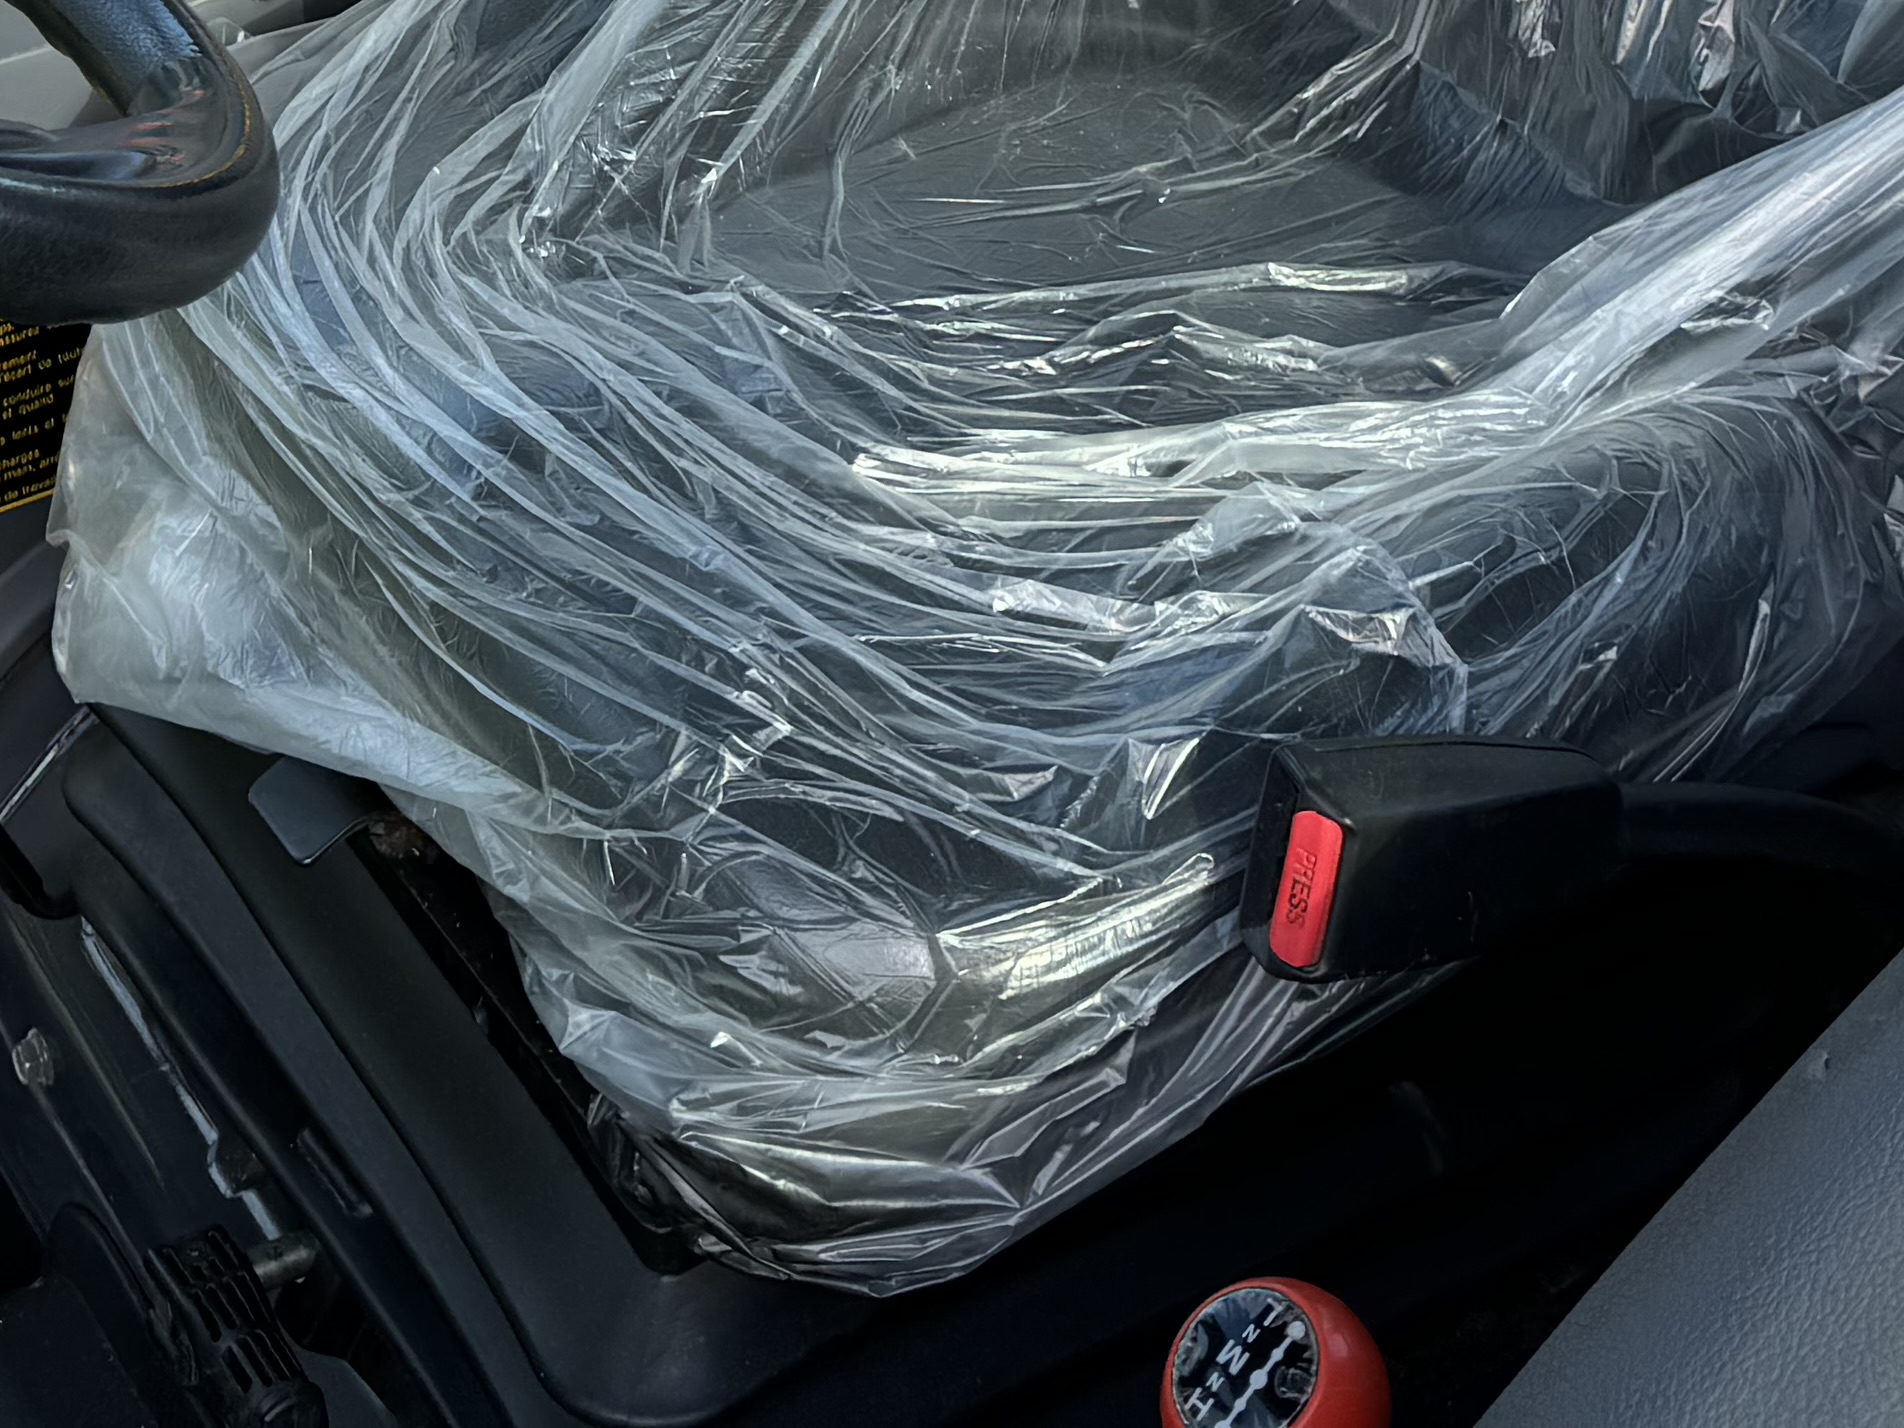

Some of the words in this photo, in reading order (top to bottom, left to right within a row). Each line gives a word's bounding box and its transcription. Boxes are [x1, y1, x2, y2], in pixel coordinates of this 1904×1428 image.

[1286, 847, 1317, 929] PRESS
[1241, 1323, 1261, 1343] N
[1206, 1371, 1225, 1393] N
[1184, 1386, 1214, 1421] H
